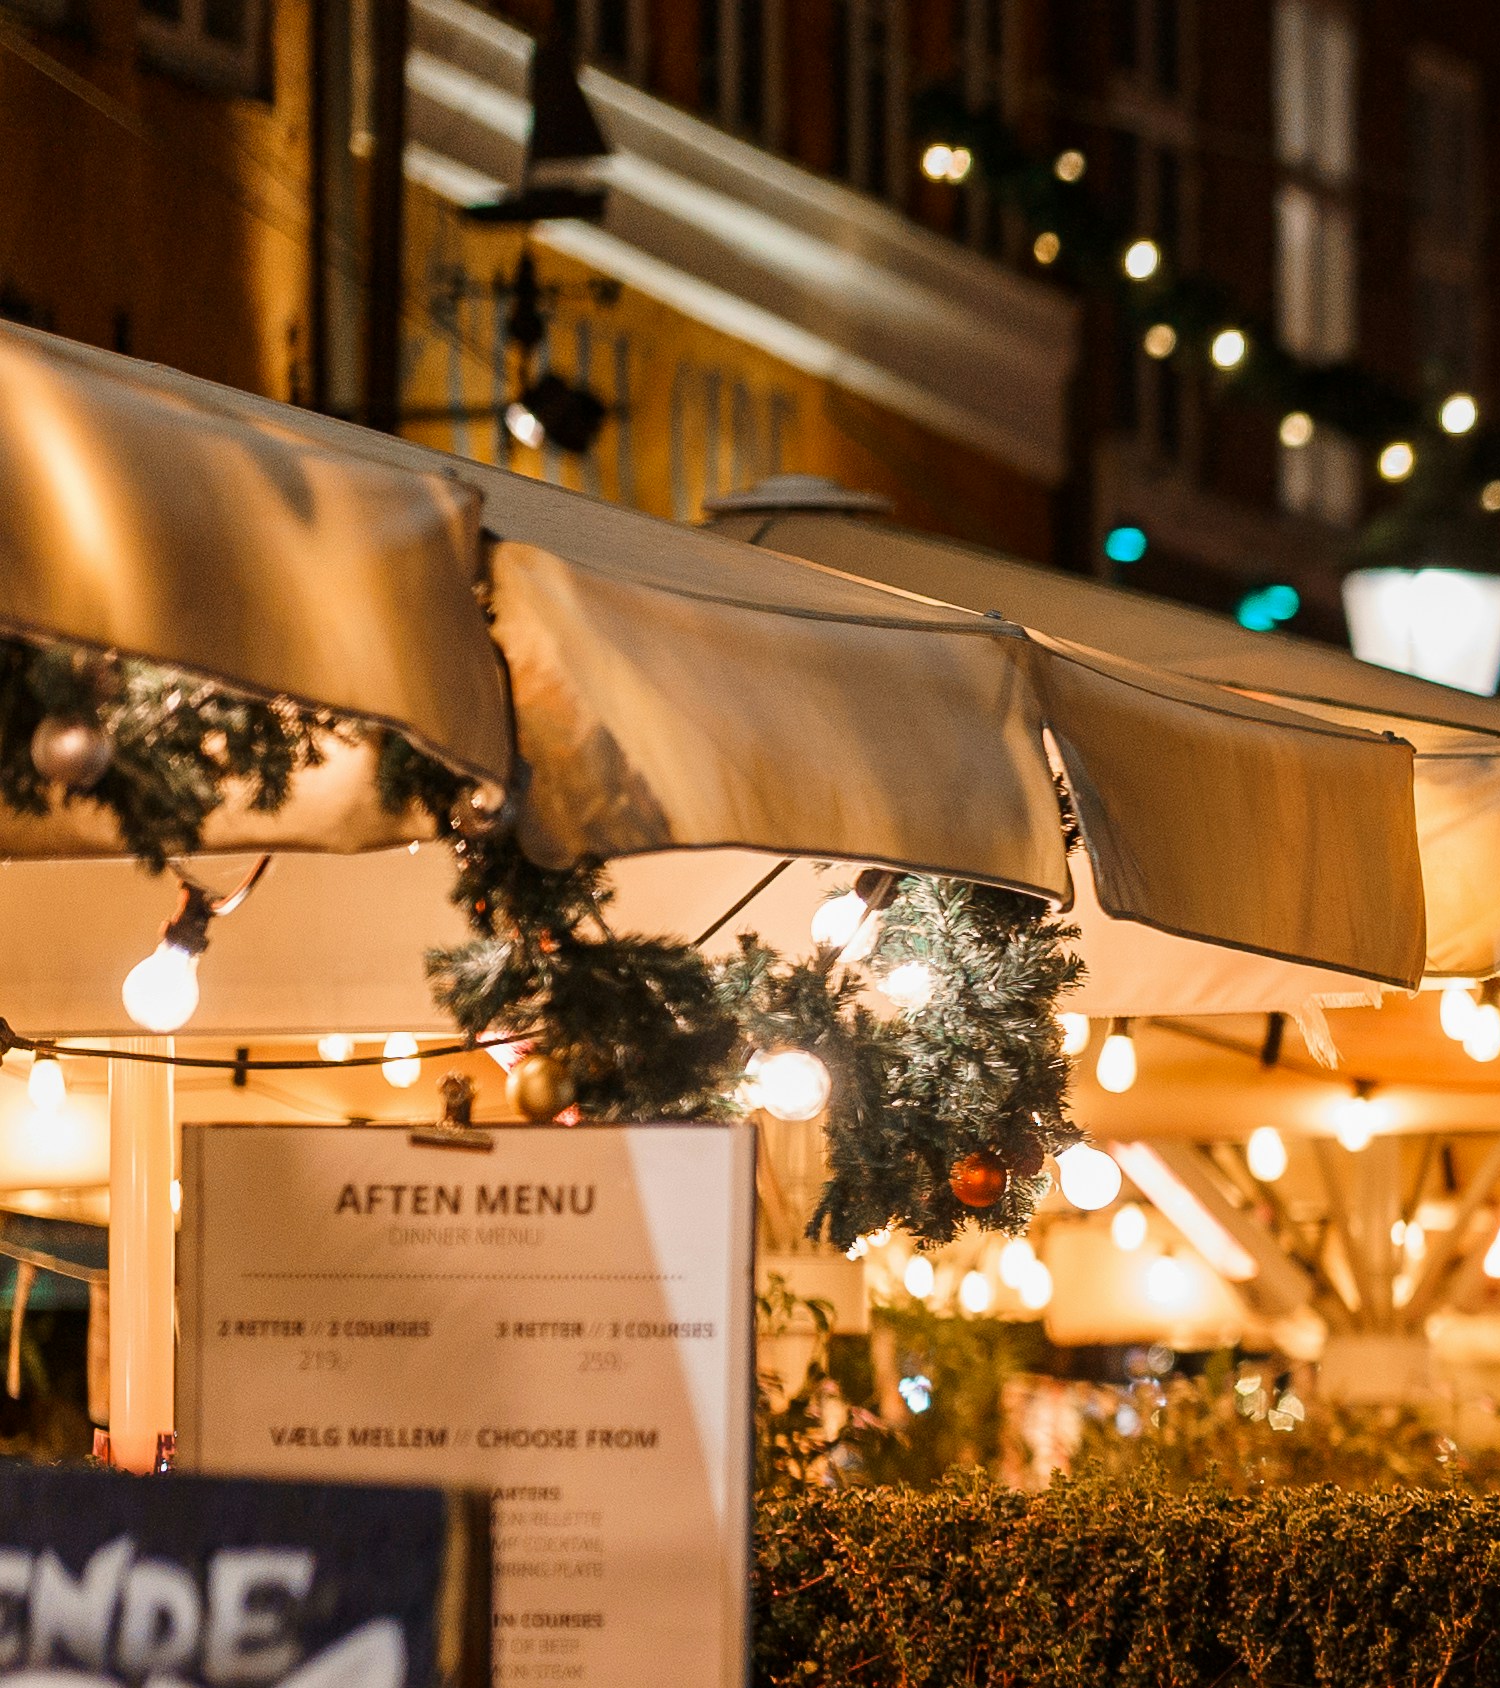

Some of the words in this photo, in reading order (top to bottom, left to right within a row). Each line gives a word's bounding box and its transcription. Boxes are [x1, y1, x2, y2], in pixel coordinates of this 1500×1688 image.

[334, 1183, 463, 1216] AFTEN
[475, 1183, 598, 1216] MENU
[387, 1226, 468, 1247] DINNER
[475, 1226, 544, 1247] MENU
[233, 1319, 305, 1338] RETTER
[343, 1319, 432, 1338] COURSES
[511, 1319, 584, 1340] RETTER
[624, 1319, 717, 1340] COURSES
[269, 1426, 341, 1449] VÆLG
[347, 1426, 448, 1449] MELLEM
[476, 1426, 578, 1449] CHOOSE
[585, 1426, 660, 1449] FROM
[490, 1486, 561, 1501] ARTERS
[520, 1613, 604, 1629] COURSES
